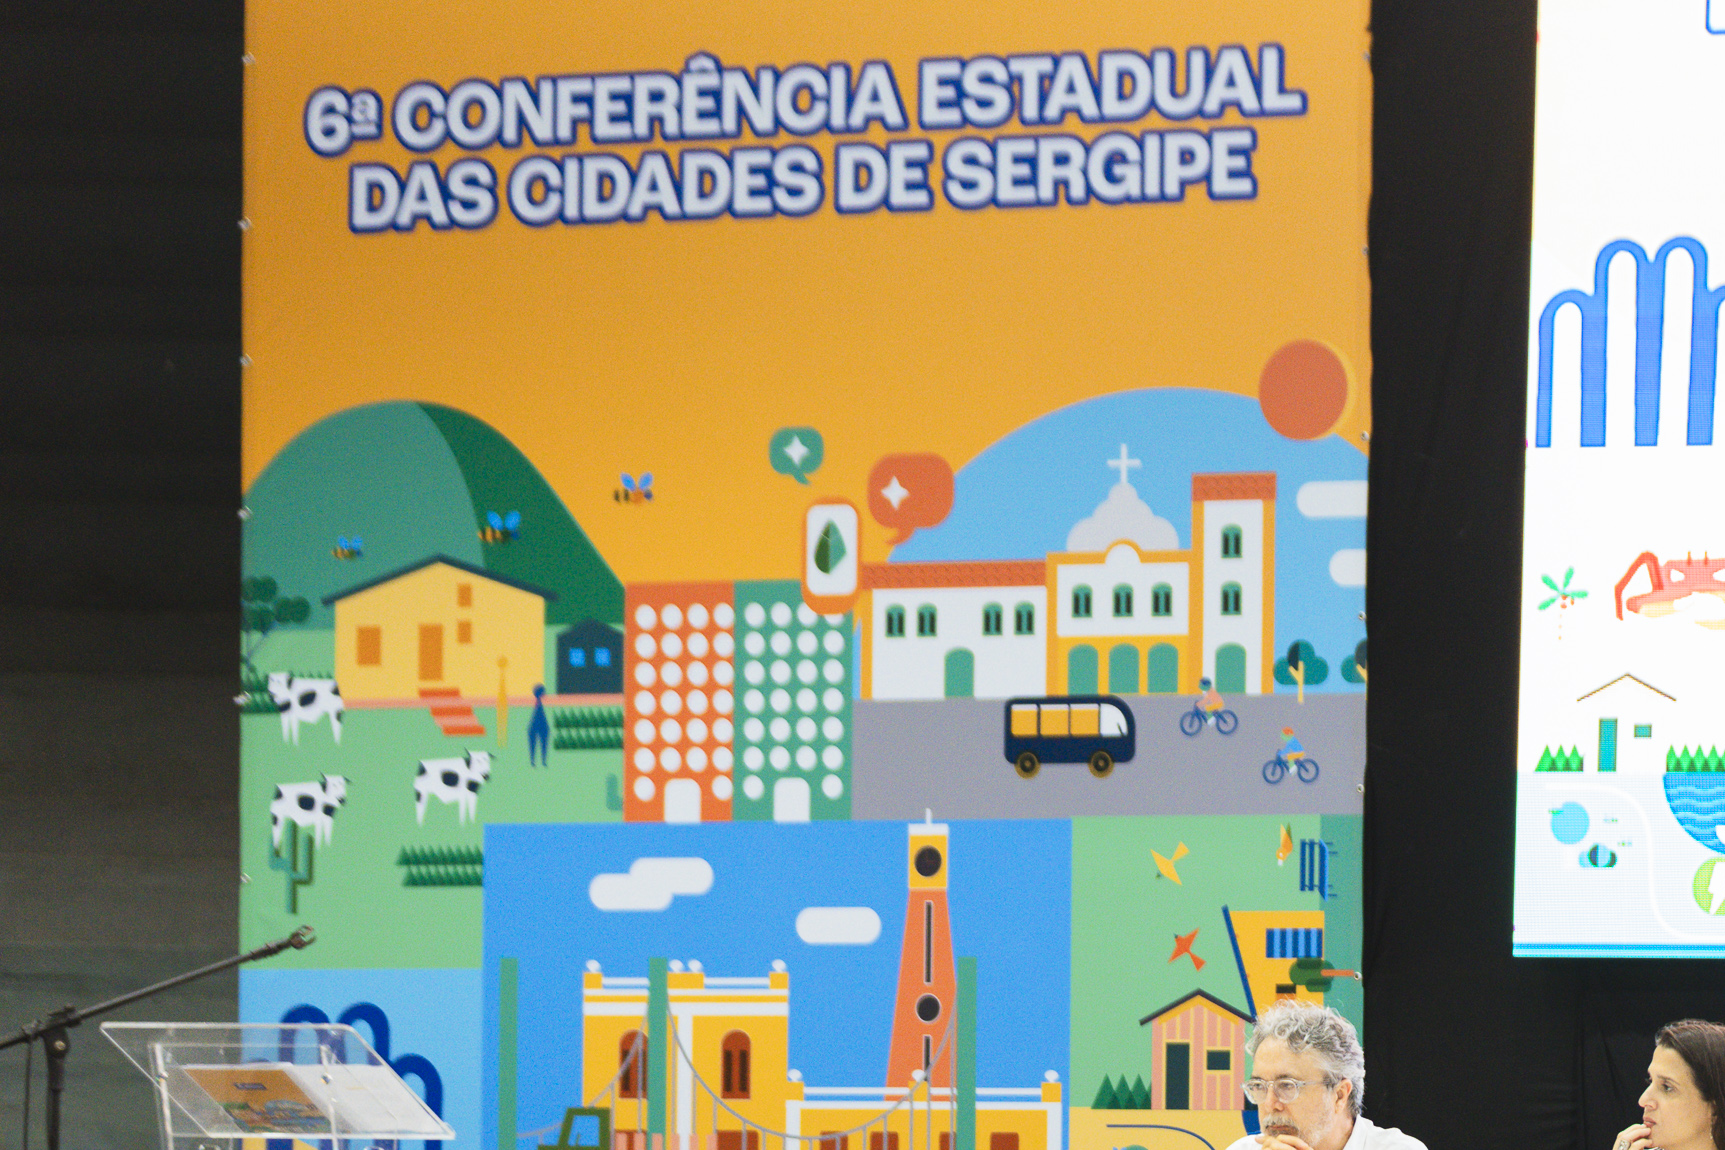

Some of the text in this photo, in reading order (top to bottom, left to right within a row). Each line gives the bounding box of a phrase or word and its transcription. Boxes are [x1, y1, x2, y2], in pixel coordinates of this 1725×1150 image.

[391, 51, 909, 154] CONFERÊNCIA
[918, 43, 1307, 131] ESTADUAL
[348, 126, 1258, 233] DAS CIDADES DE SERGIPE
